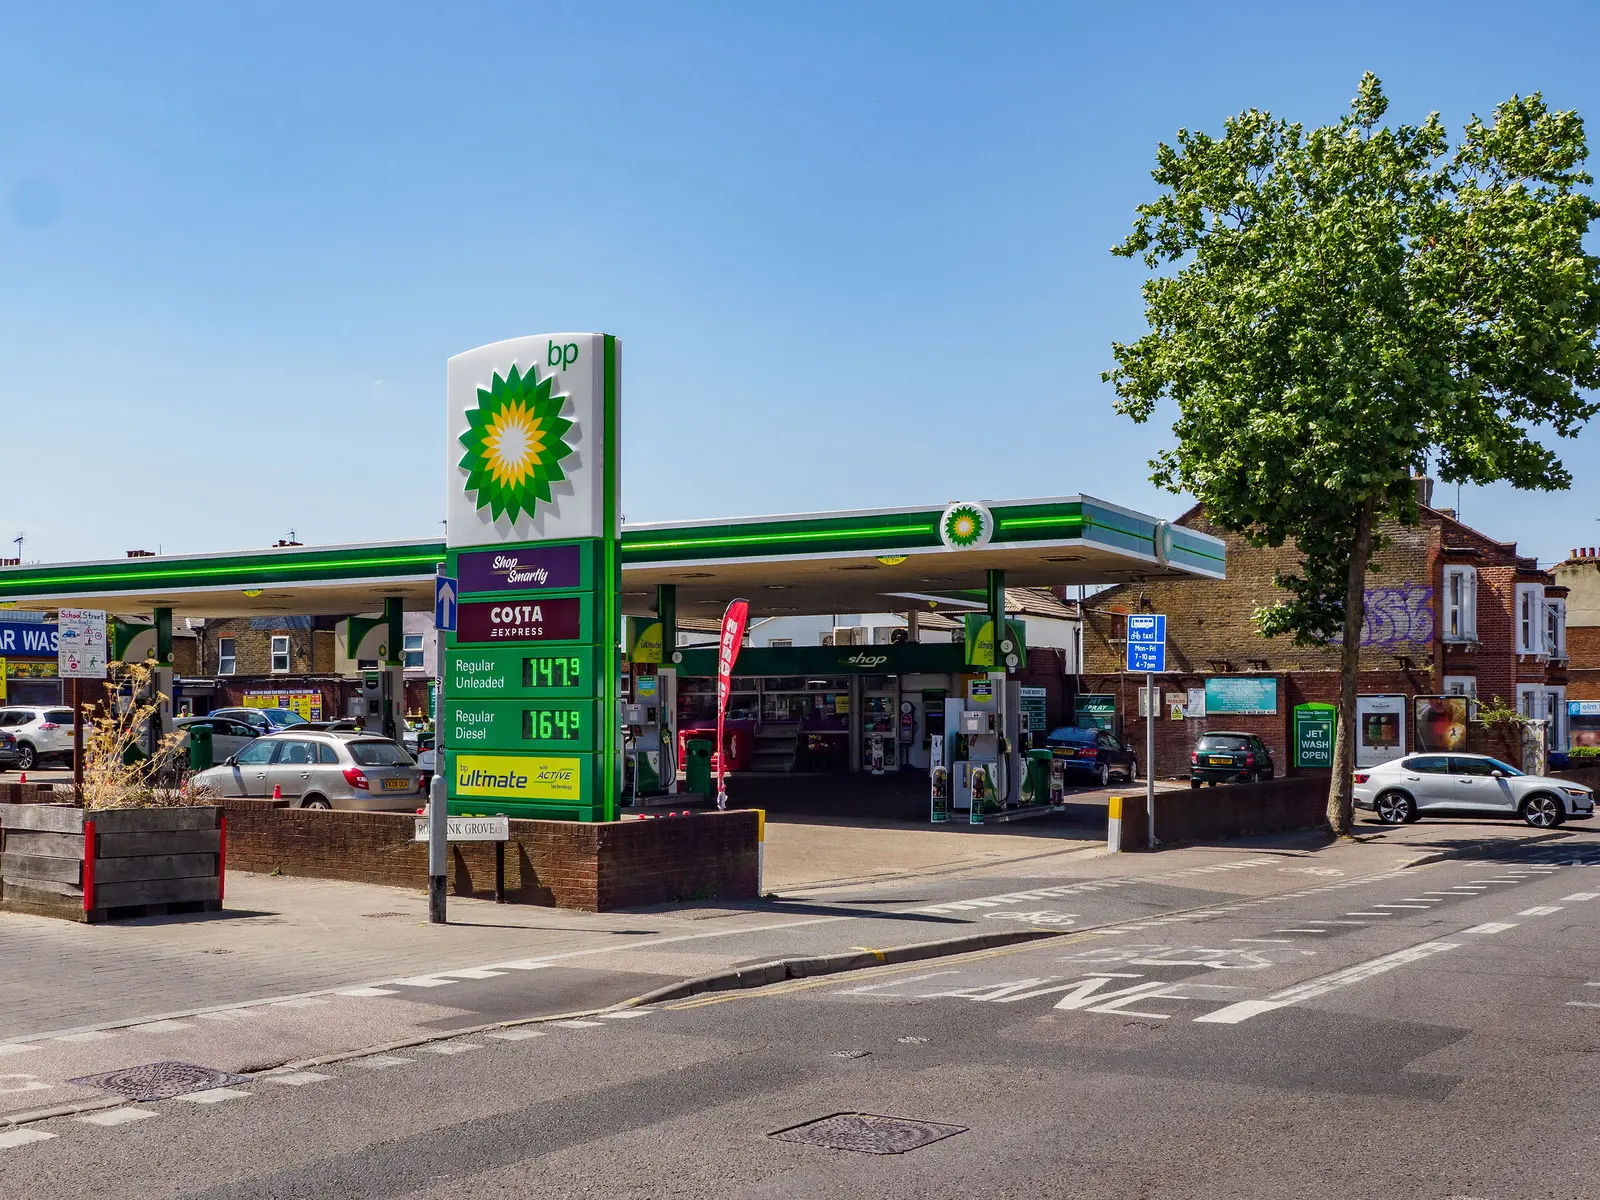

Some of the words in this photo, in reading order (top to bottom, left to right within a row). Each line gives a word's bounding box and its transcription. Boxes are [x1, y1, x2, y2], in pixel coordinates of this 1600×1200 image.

[548, 340, 578, 371] bp
[492, 556, 518, 570] Shop
[508, 568, 548, 584] Smartly
[60, 610, 81, 619] School
[83, 611, 104, 620] Street
[491, 606, 543, 625] COSTA
[498, 628, 543, 637] EXPRESS
[456, 659, 495, 674] Regular
[848, 652, 888, 667] shop
[456, 676, 504, 688] Unleaded
[456, 710, 495, 724] Regular
[456, 727, 486, 739] Diesel
[460, 764, 468, 773] bp
[460, 770, 528, 788] ultimate
[418, 823, 461, 834] RONK
[465, 823, 495, 834] GROVE
